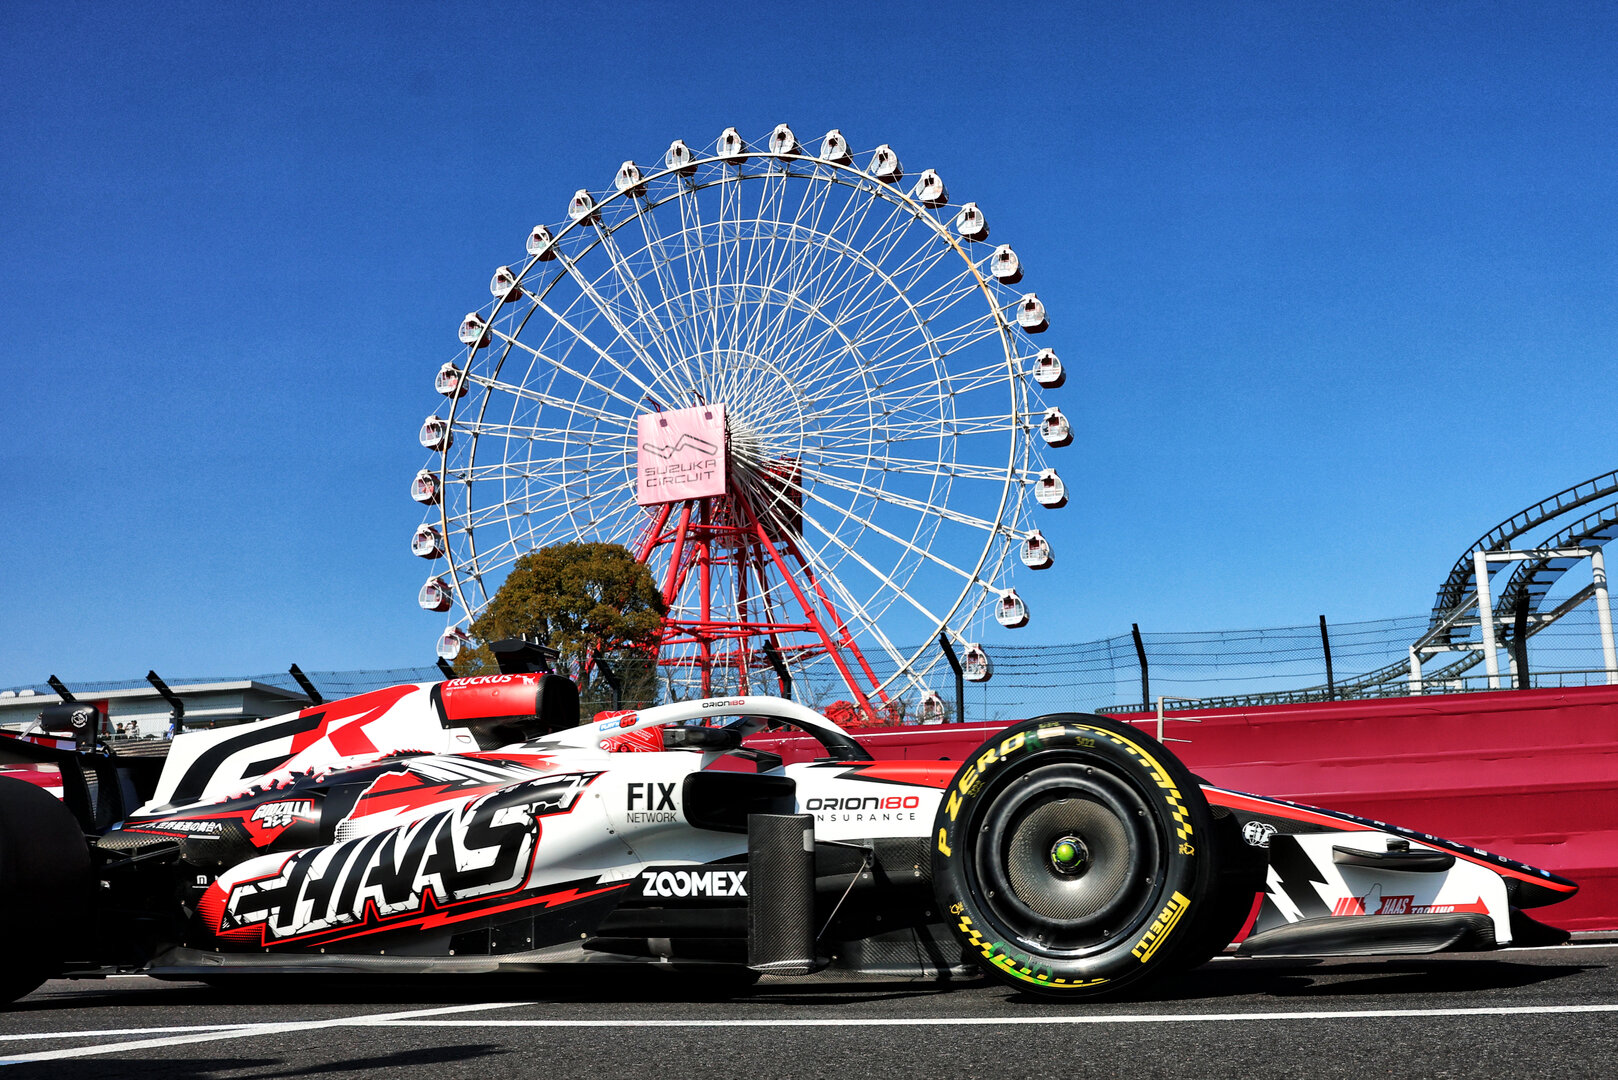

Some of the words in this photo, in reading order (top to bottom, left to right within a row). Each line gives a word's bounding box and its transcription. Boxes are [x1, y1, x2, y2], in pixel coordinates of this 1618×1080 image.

[644, 459, 717, 477] SUZUKA
[646, 471, 715, 488] CIRCUIT
[447, 674, 513, 687] RUCKUS
[944, 731, 1025, 822] ZERO
[627, 782, 677, 811] FIX
[805, 795, 920, 811] ORION180
[250, 800, 312, 822] GODZILLA
[626, 812, 678, 823] NETWORK
[816, 812, 916, 822] NSURANCE
[938, 827, 952, 858] P
[641, 870, 749, 898] ZOOMEX
[1381, 898, 1410, 915] HAAS
[1130, 890, 1192, 964] PIRELLI
